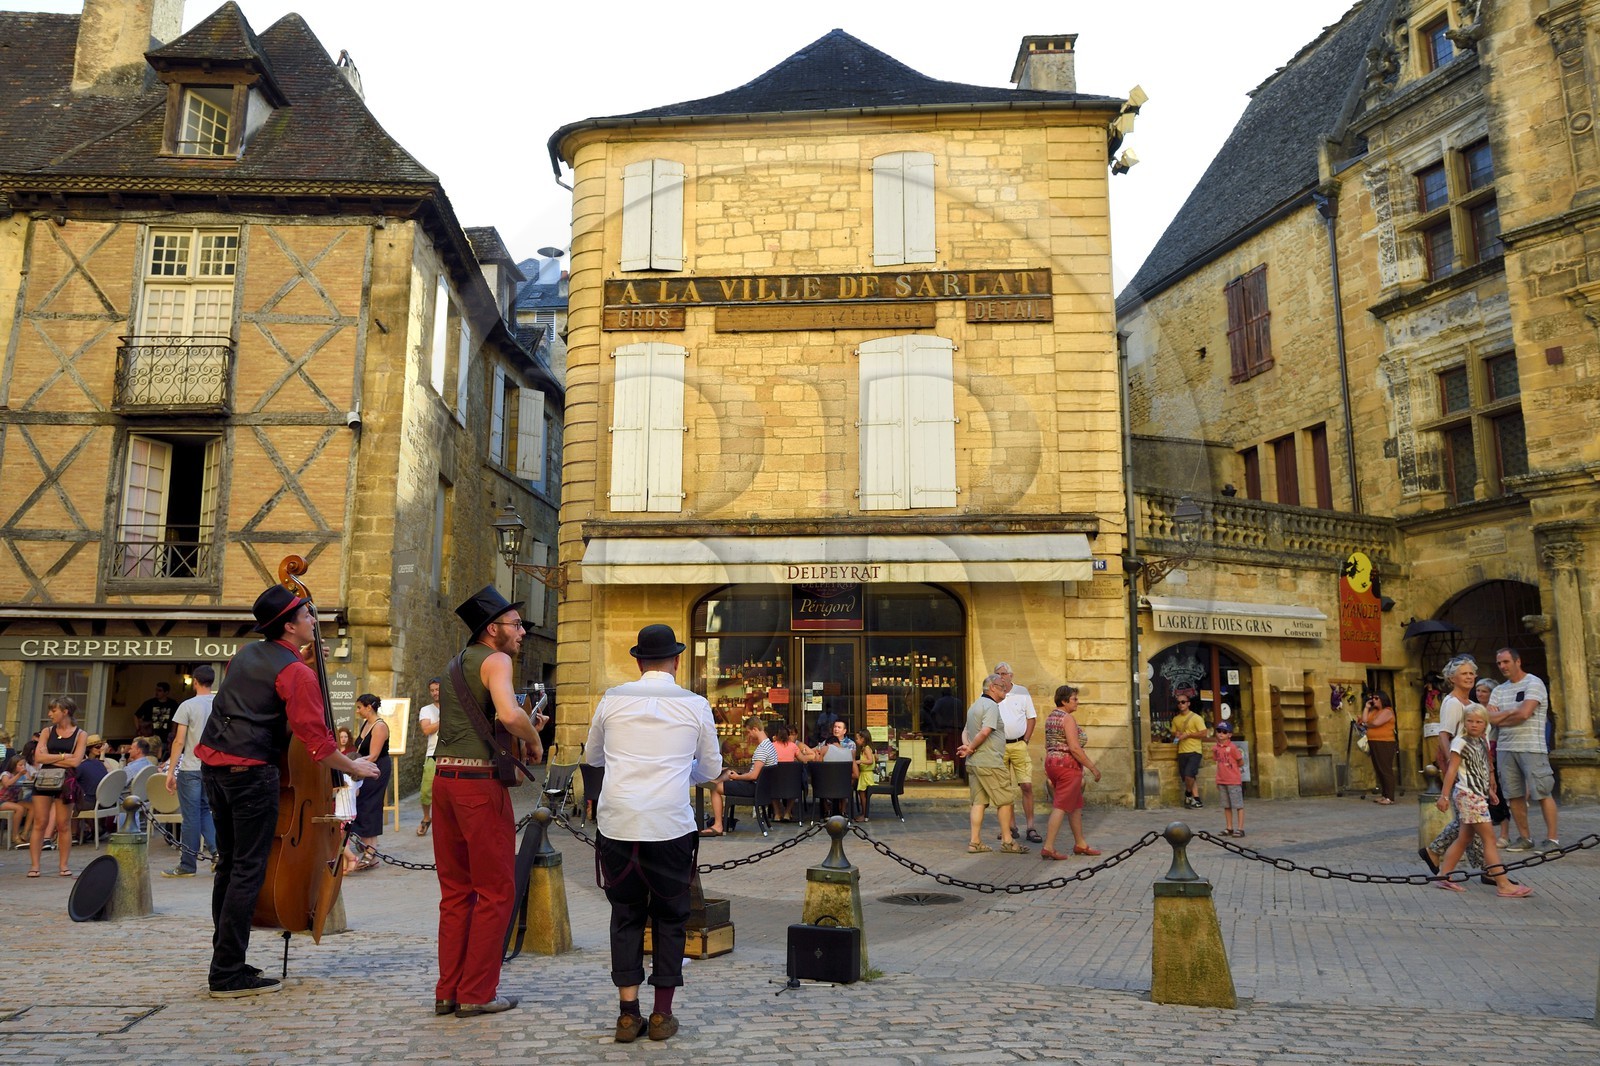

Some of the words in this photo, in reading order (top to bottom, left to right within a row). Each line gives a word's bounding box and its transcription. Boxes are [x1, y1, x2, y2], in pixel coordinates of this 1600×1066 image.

[620, 281, 641, 304] A
[656, 279, 702, 304] LA
[718, 277, 822, 301] VILLE
[895, 271, 1035, 297] SARLAT
[618, 309, 670, 328] GROS
[1095, 560, 1105, 569] 16
[787, 566, 881, 582] DELPEYRAT
[800, 595, 856, 617] Périgord
[1212, 617, 1243, 632] FOIES
[1245, 619, 1273, 633] GRAS
[1292, 620, 1314, 629] Artisan
[1284, 628, 1323, 638] Conserveur
[20, 639, 173, 657] CREPERIE
[194, 638, 237, 657] lou
